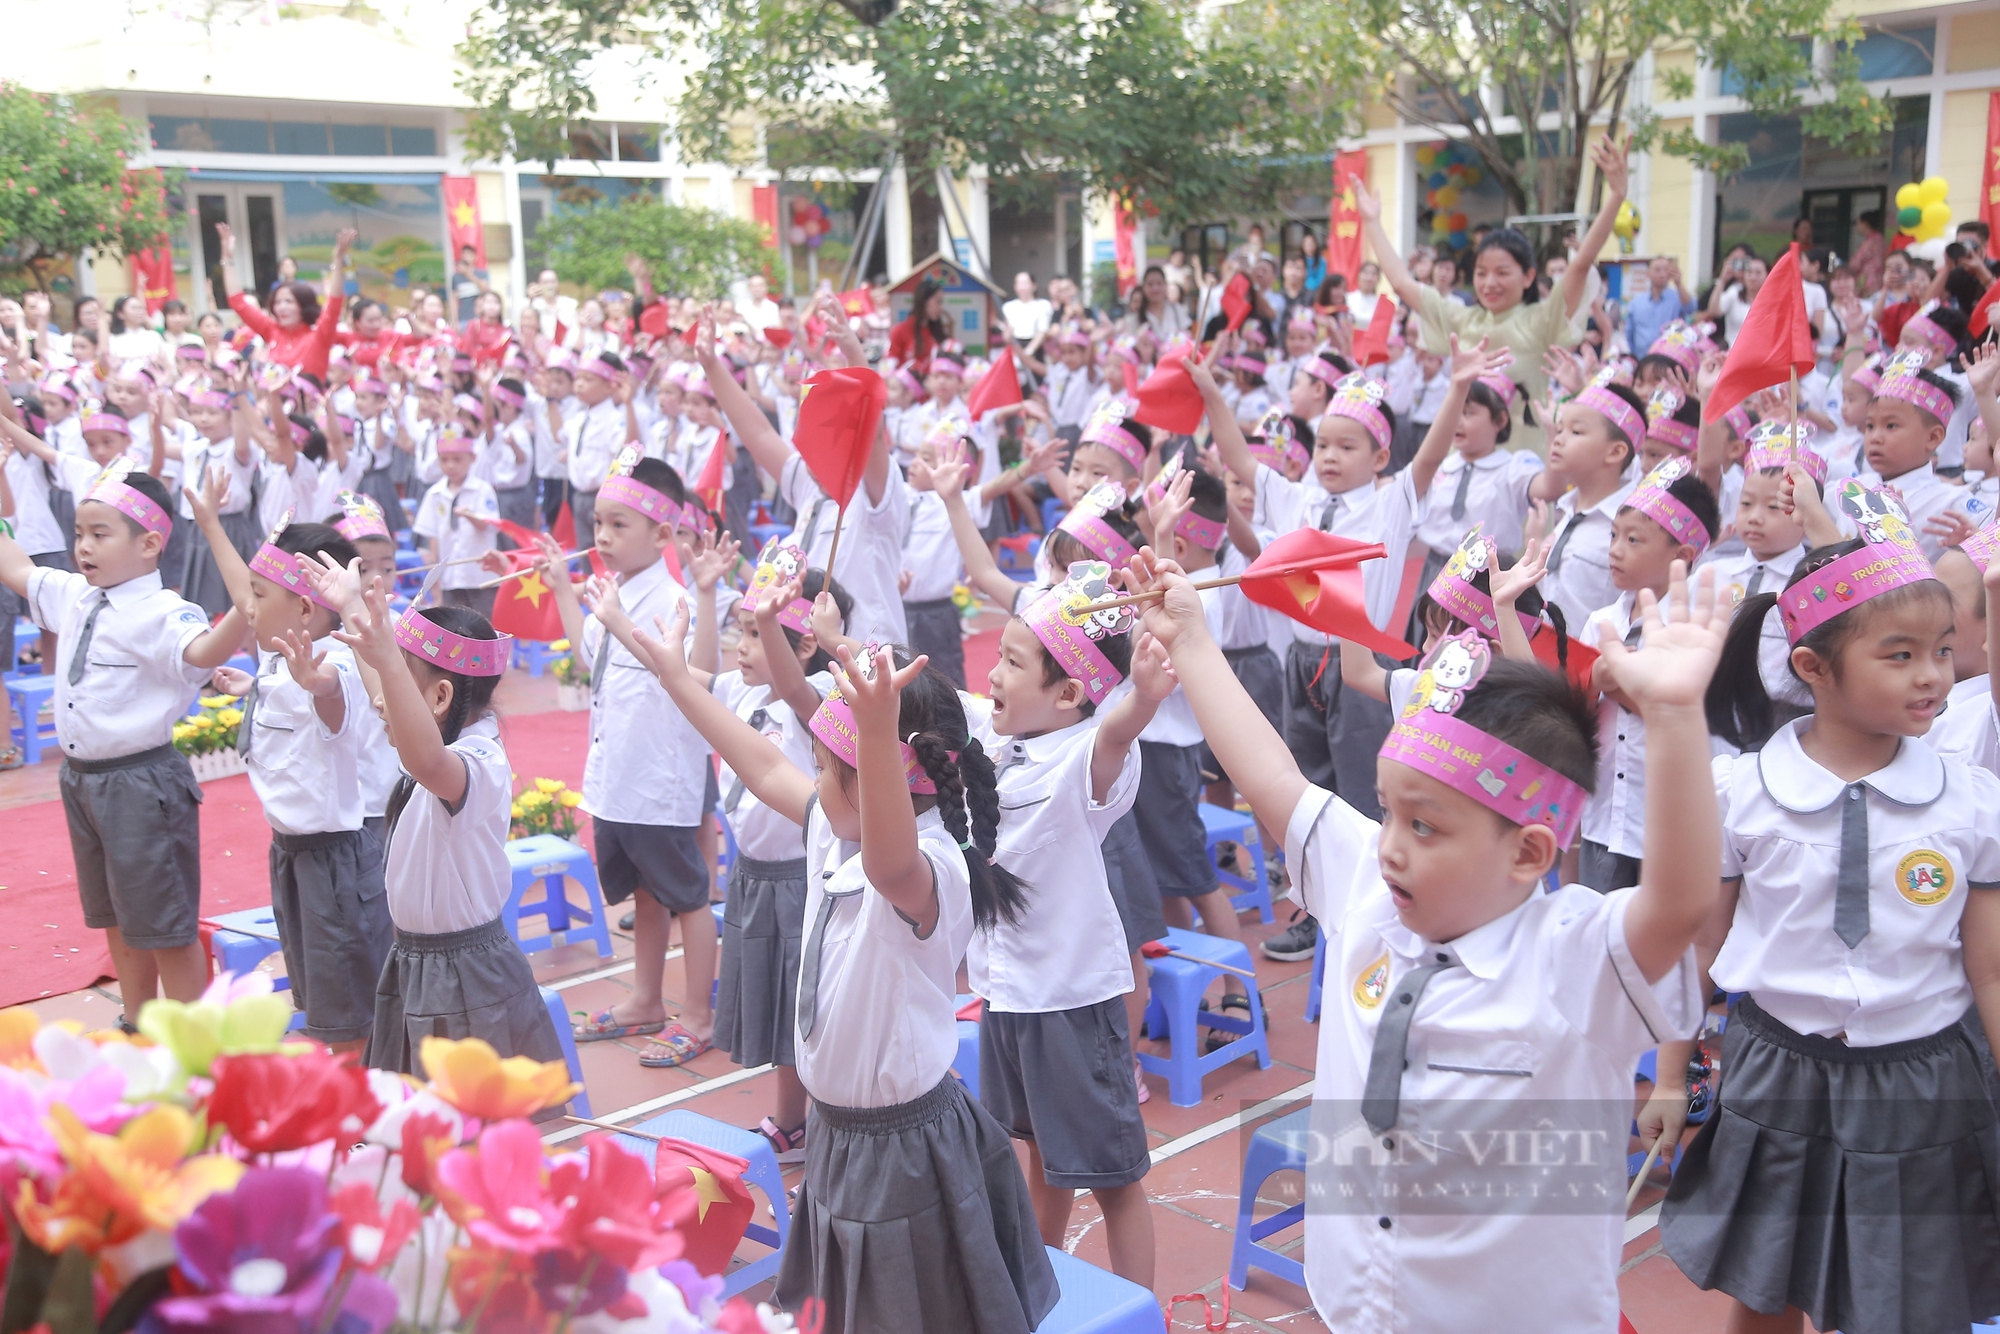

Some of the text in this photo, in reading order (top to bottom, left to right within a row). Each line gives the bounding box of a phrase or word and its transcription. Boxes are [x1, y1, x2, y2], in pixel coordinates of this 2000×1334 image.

[1851, 555, 1900, 582] TRƯỜNG
[1452, 588, 1468, 605] VĂN
[1467, 601, 1485, 614] KHÊ
[410, 627, 425, 640] KHÊ
[1054, 624, 1072, 644] HỌC
[1070, 643, 1086, 662] VĂN
[1083, 660, 1100, 676] KHÊ
[820, 704, 834, 723] HỌC
[833, 718, 850, 738] VĂN
[1423, 732, 1451, 753] VĂN
[1452, 746, 1484, 768] KHÊ
